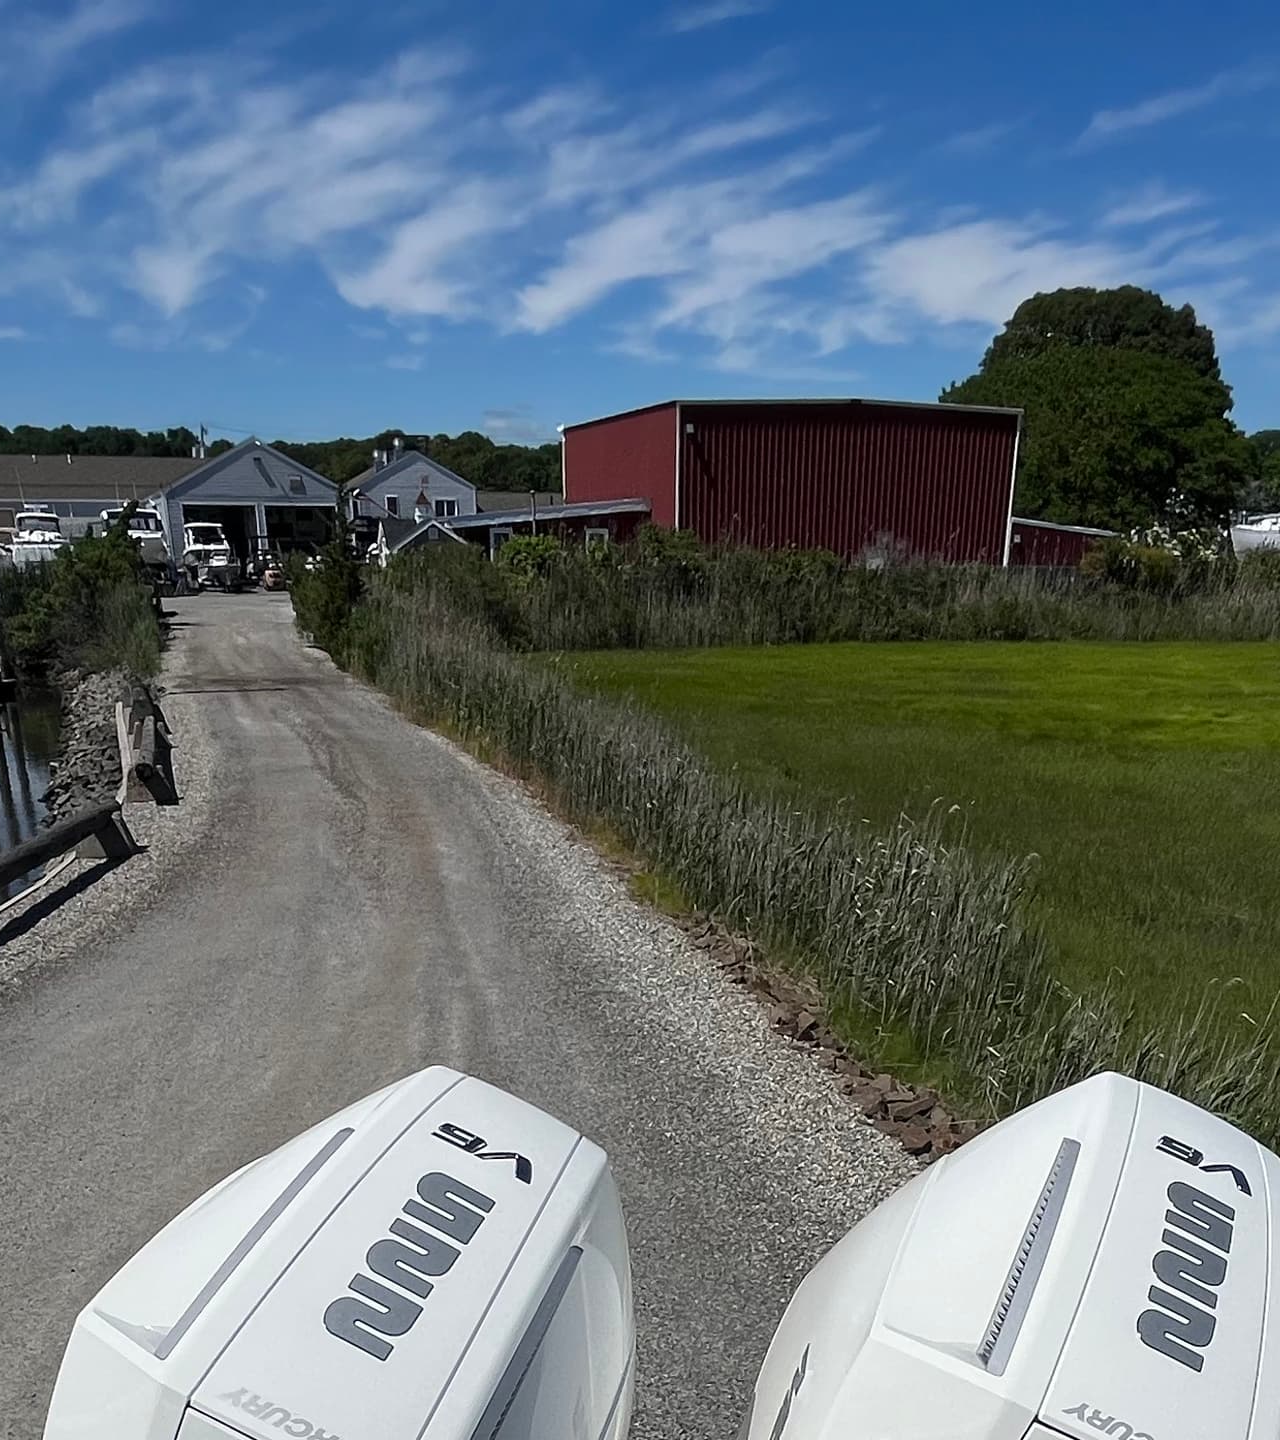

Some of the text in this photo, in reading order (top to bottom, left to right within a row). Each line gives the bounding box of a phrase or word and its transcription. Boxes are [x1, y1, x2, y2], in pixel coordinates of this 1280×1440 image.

[430, 1121, 533, 1186] V6
[1154, 1134, 1253, 1199] V6
[322, 1171, 497, 1362] 225
[1136, 1181, 1237, 1374] 225
